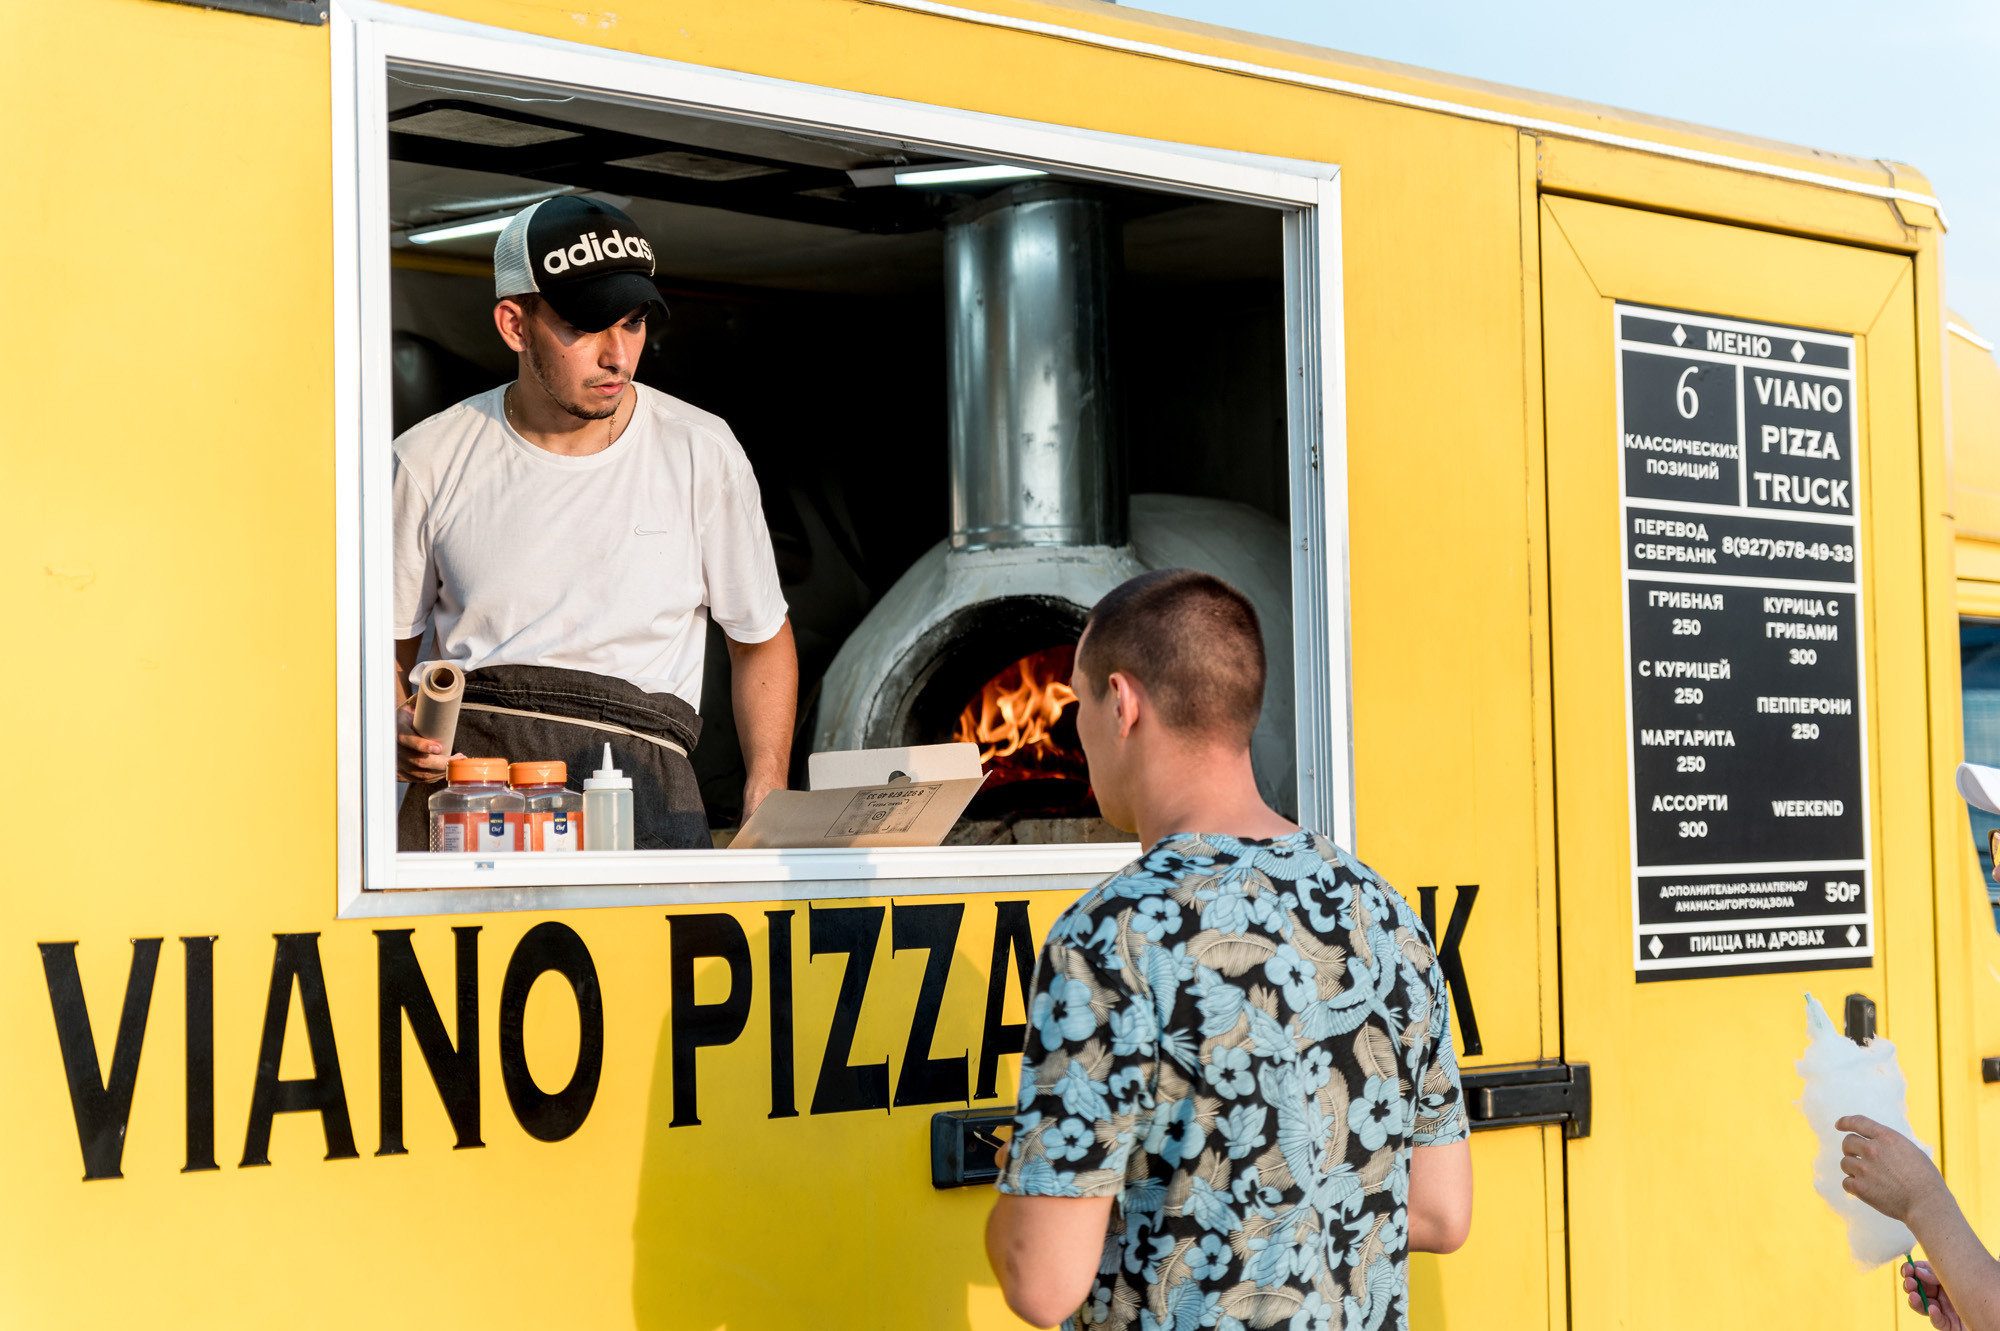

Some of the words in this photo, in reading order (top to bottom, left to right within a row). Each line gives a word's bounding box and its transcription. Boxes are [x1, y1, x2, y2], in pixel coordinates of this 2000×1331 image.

[543, 230, 652, 274] adidas
[1706, 330, 1772, 357] МЕНЮ
[1676, 366, 1699, 419] 6
[1754, 376, 1842, 413] VIANO
[1625, 433, 1738, 459] КЛАССИЧЕСКИХ
[1761, 425, 1840, 460] PIZZA
[1647, 459, 1719, 480] ПОЗИЦИЙ
[1753, 471, 1849, 508] TRUCK
[1635, 518, 1708, 541] ПЕРЕВОД
[1635, 543, 1716, 564] СБЕРБАНК
[1722, 536, 1853, 562] 8(927)678-49-33
[1649, 590, 1723, 610] ГРИБНАЯ
[1764, 597, 1825, 617] КУРИЦА
[1827, 601, 1838, 616] С
[1672, 619, 1701, 635] 250
[1766, 622, 1837, 641] ГРИБАМИ
[1790, 649, 1817, 665] 300
[1639, 660, 1651, 676] С
[1655, 659, 1730, 681] КУРИЦЕЙ
[1675, 688, 1703, 704] 250
[1757, 697, 1851, 714] ПЕППЕРОНИ
[1641, 729, 1735, 746] МАРГАРИТА
[1792, 723, 1819, 739] 250
[1677, 756, 1705, 772] 250
[1652, 795, 1728, 811] АССОРТИ
[1772, 800, 1843, 816] WEEKEND
[1679, 821, 1707, 837] 300
[1690, 934, 1743, 952] ПИЦЦА
[1746, 933, 1766, 948] НА
[1768, 930, 1825, 949] ДРОВАХ
[37, 920, 604, 1182] VIANO
[666, 899, 1037, 1127] PIZZA
